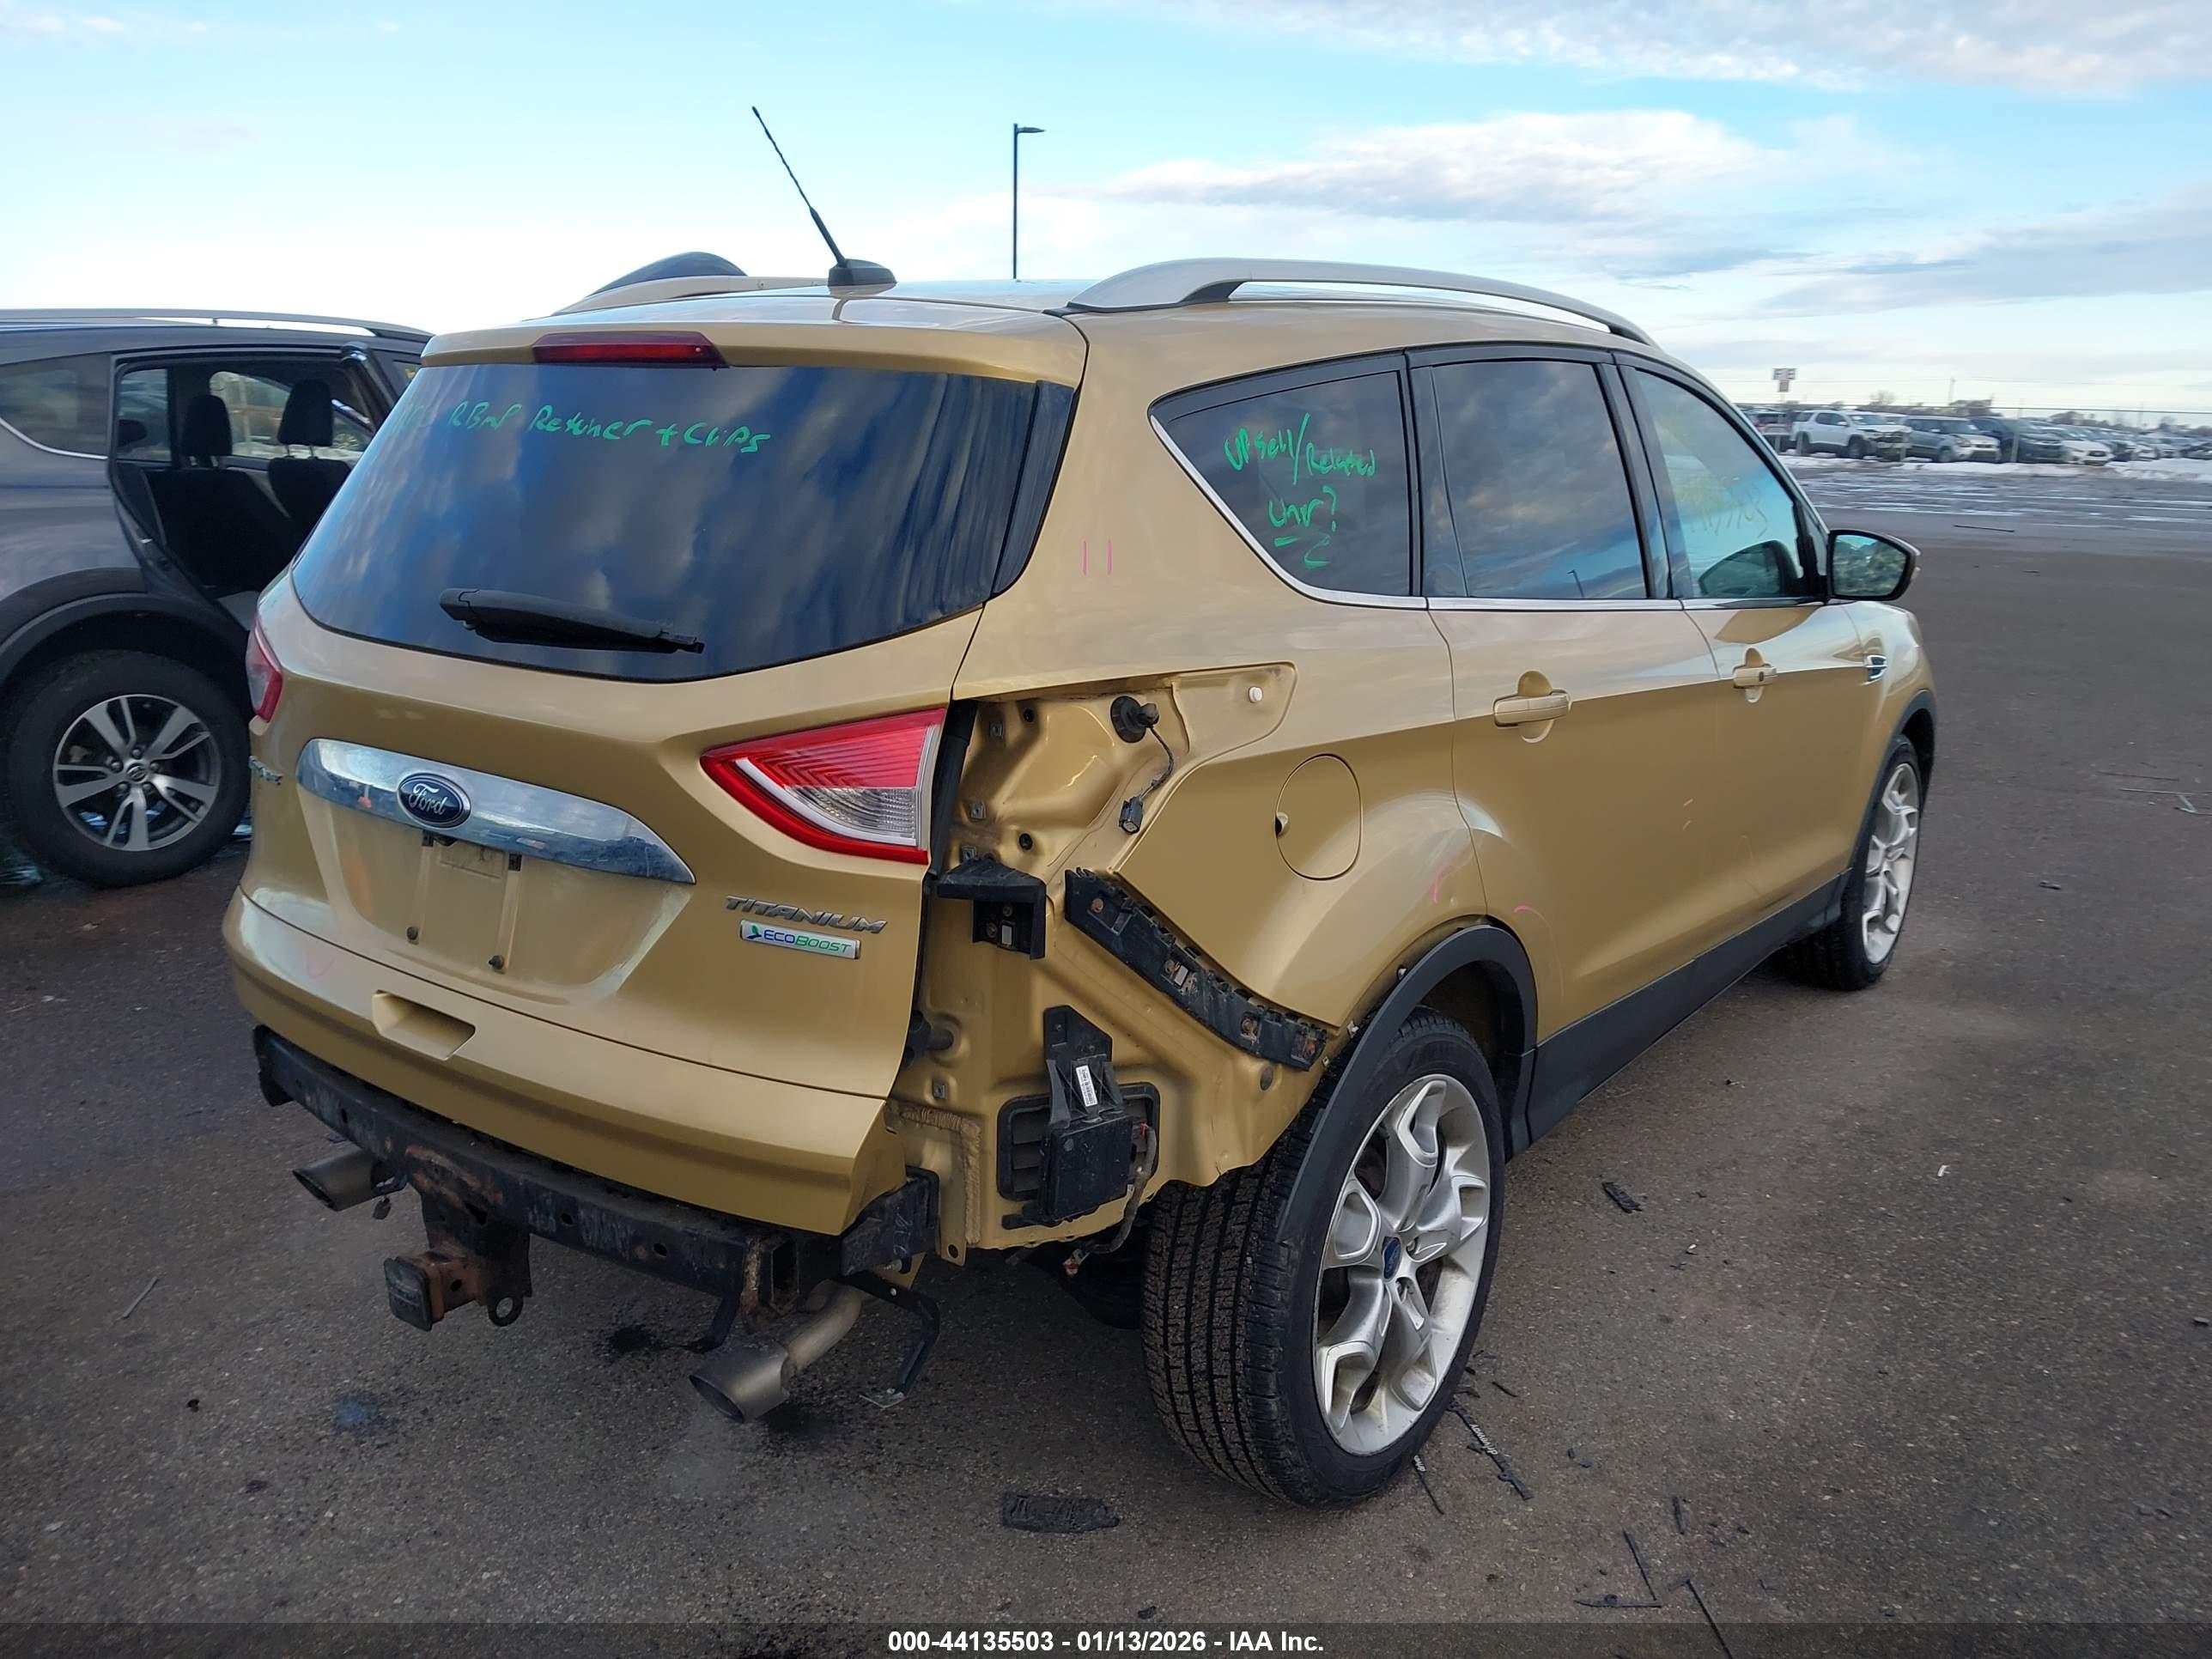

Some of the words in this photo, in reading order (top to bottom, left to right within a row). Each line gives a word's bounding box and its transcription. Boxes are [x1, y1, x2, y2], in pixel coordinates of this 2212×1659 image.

[409, 782, 449, 816] Ford
[726, 895, 888, 934] TITANIUM
[763, 929, 853, 954] ECOBOOST
